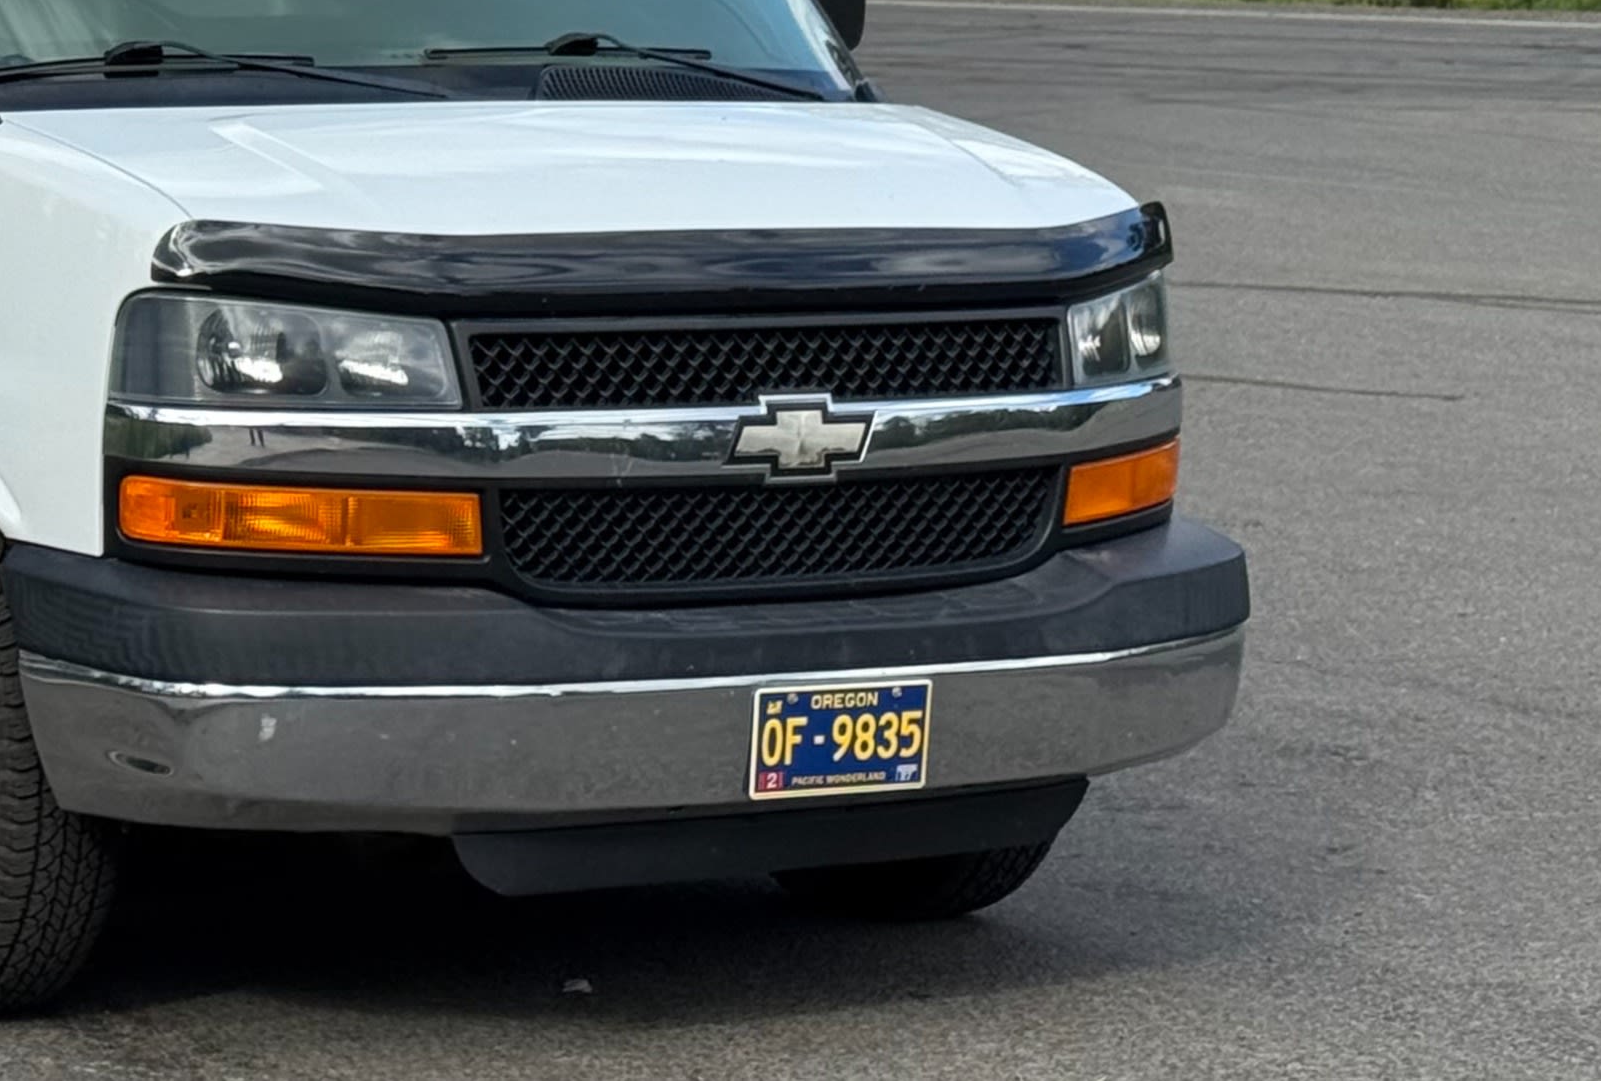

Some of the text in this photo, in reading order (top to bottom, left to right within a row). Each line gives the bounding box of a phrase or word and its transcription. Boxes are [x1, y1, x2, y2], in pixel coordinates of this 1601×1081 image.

[811, 692, 878, 709] OREGON
[766, 773, 777, 788] 2
[792, 774, 823, 786] PACIFIC
[826, 771, 886, 784] WONDERLAND
